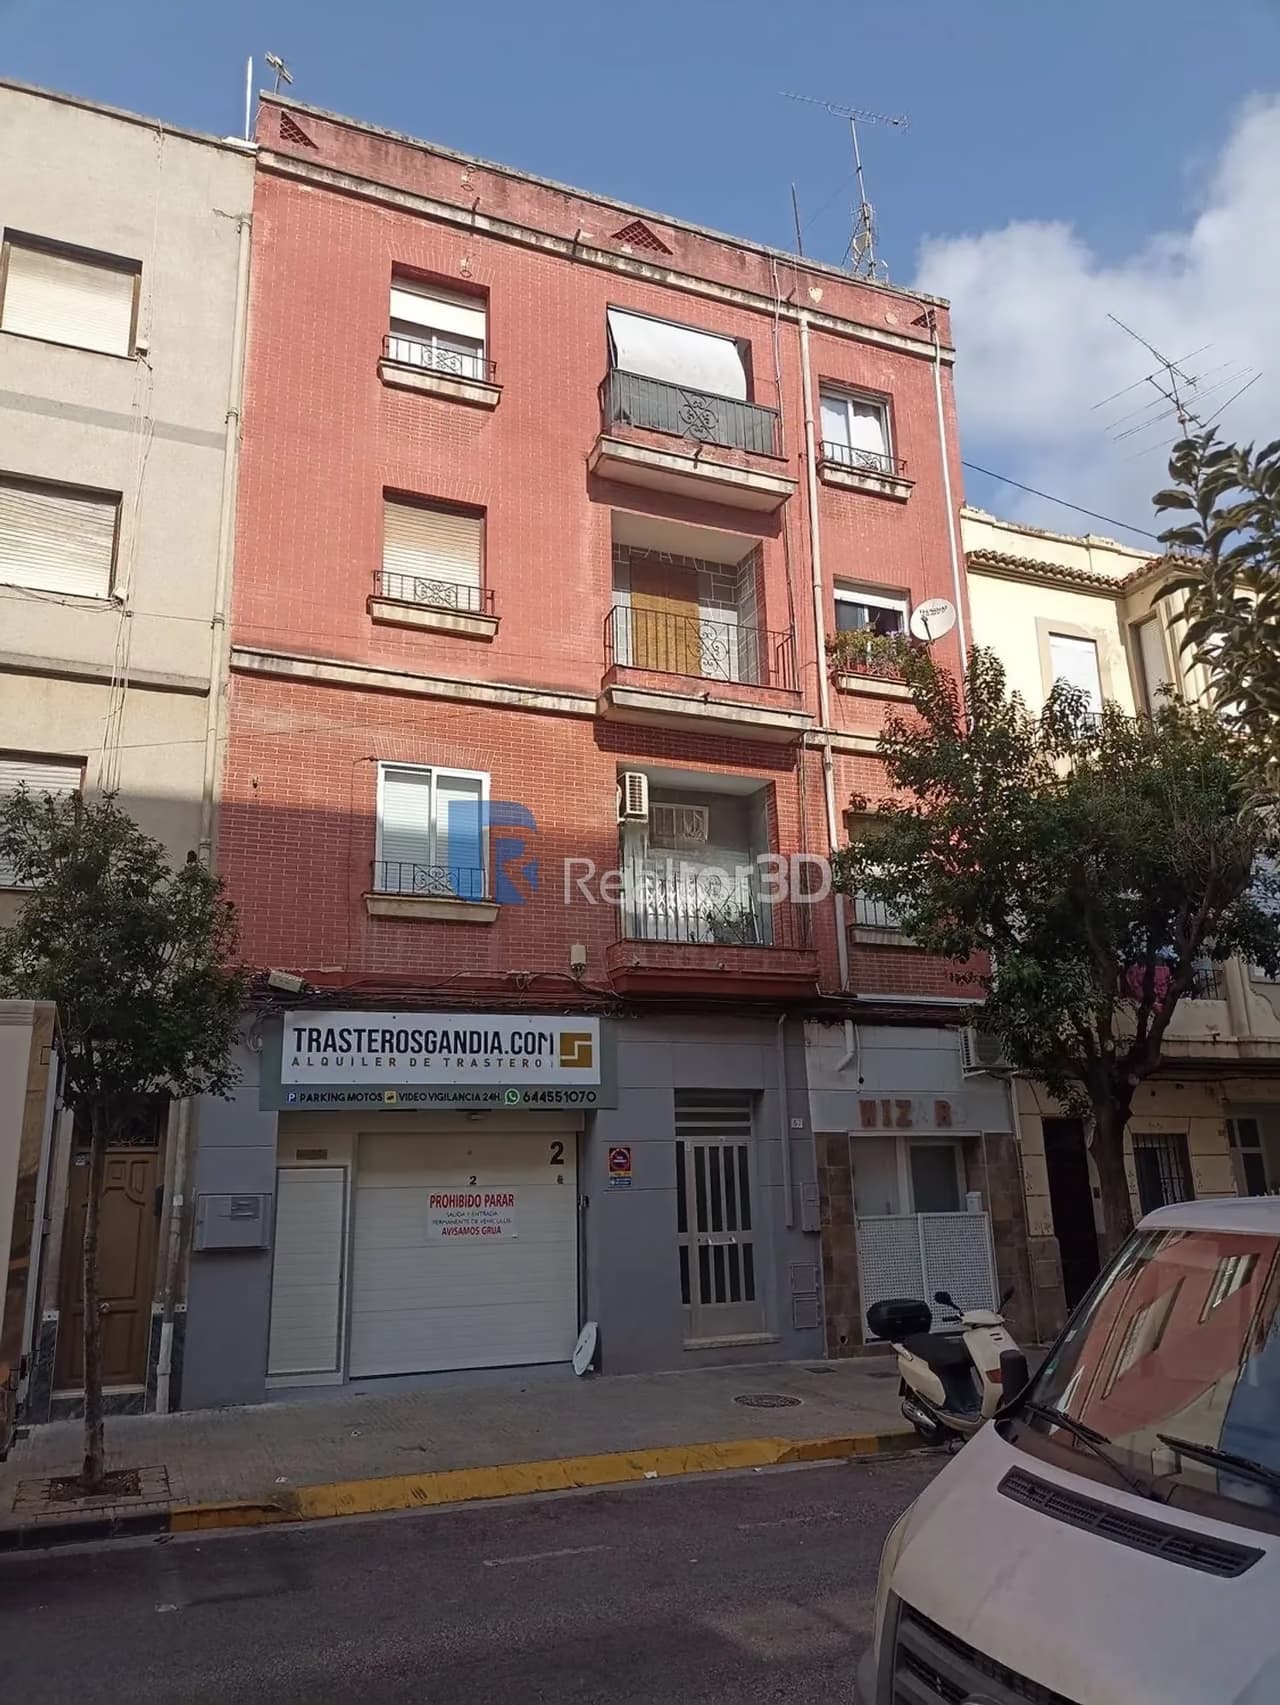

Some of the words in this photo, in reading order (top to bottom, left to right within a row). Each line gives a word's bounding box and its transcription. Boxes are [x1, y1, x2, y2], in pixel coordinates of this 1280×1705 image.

[293, 1027, 555, 1055] TRASTEROSGANDIA.COM
[291, 1057, 397, 1068] ALQUILER
[409, 1058, 432, 1068] DE
[444, 1058, 555, 1069] TRASTERO
[299, 1092, 346, 1103] PARKING
[347, 1092, 383, 1102] MOTOS
[399, 1091, 427, 1102] VIDEO
[428, 1091, 481, 1102] VIGILANCIA
[482, 1091, 501, 1102] 24H
[523, 1090, 597, 1104] 644551070
[550, 1141, 564, 1165] 2
[469, 1176, 477, 1185] 2
[430, 1194, 482, 1209] PROHIBIDO
[484, 1193, 515, 1208] PARAR
[441, 1226, 480, 1236] AVISAMOS
[481, 1225, 502, 1235] GRUA
